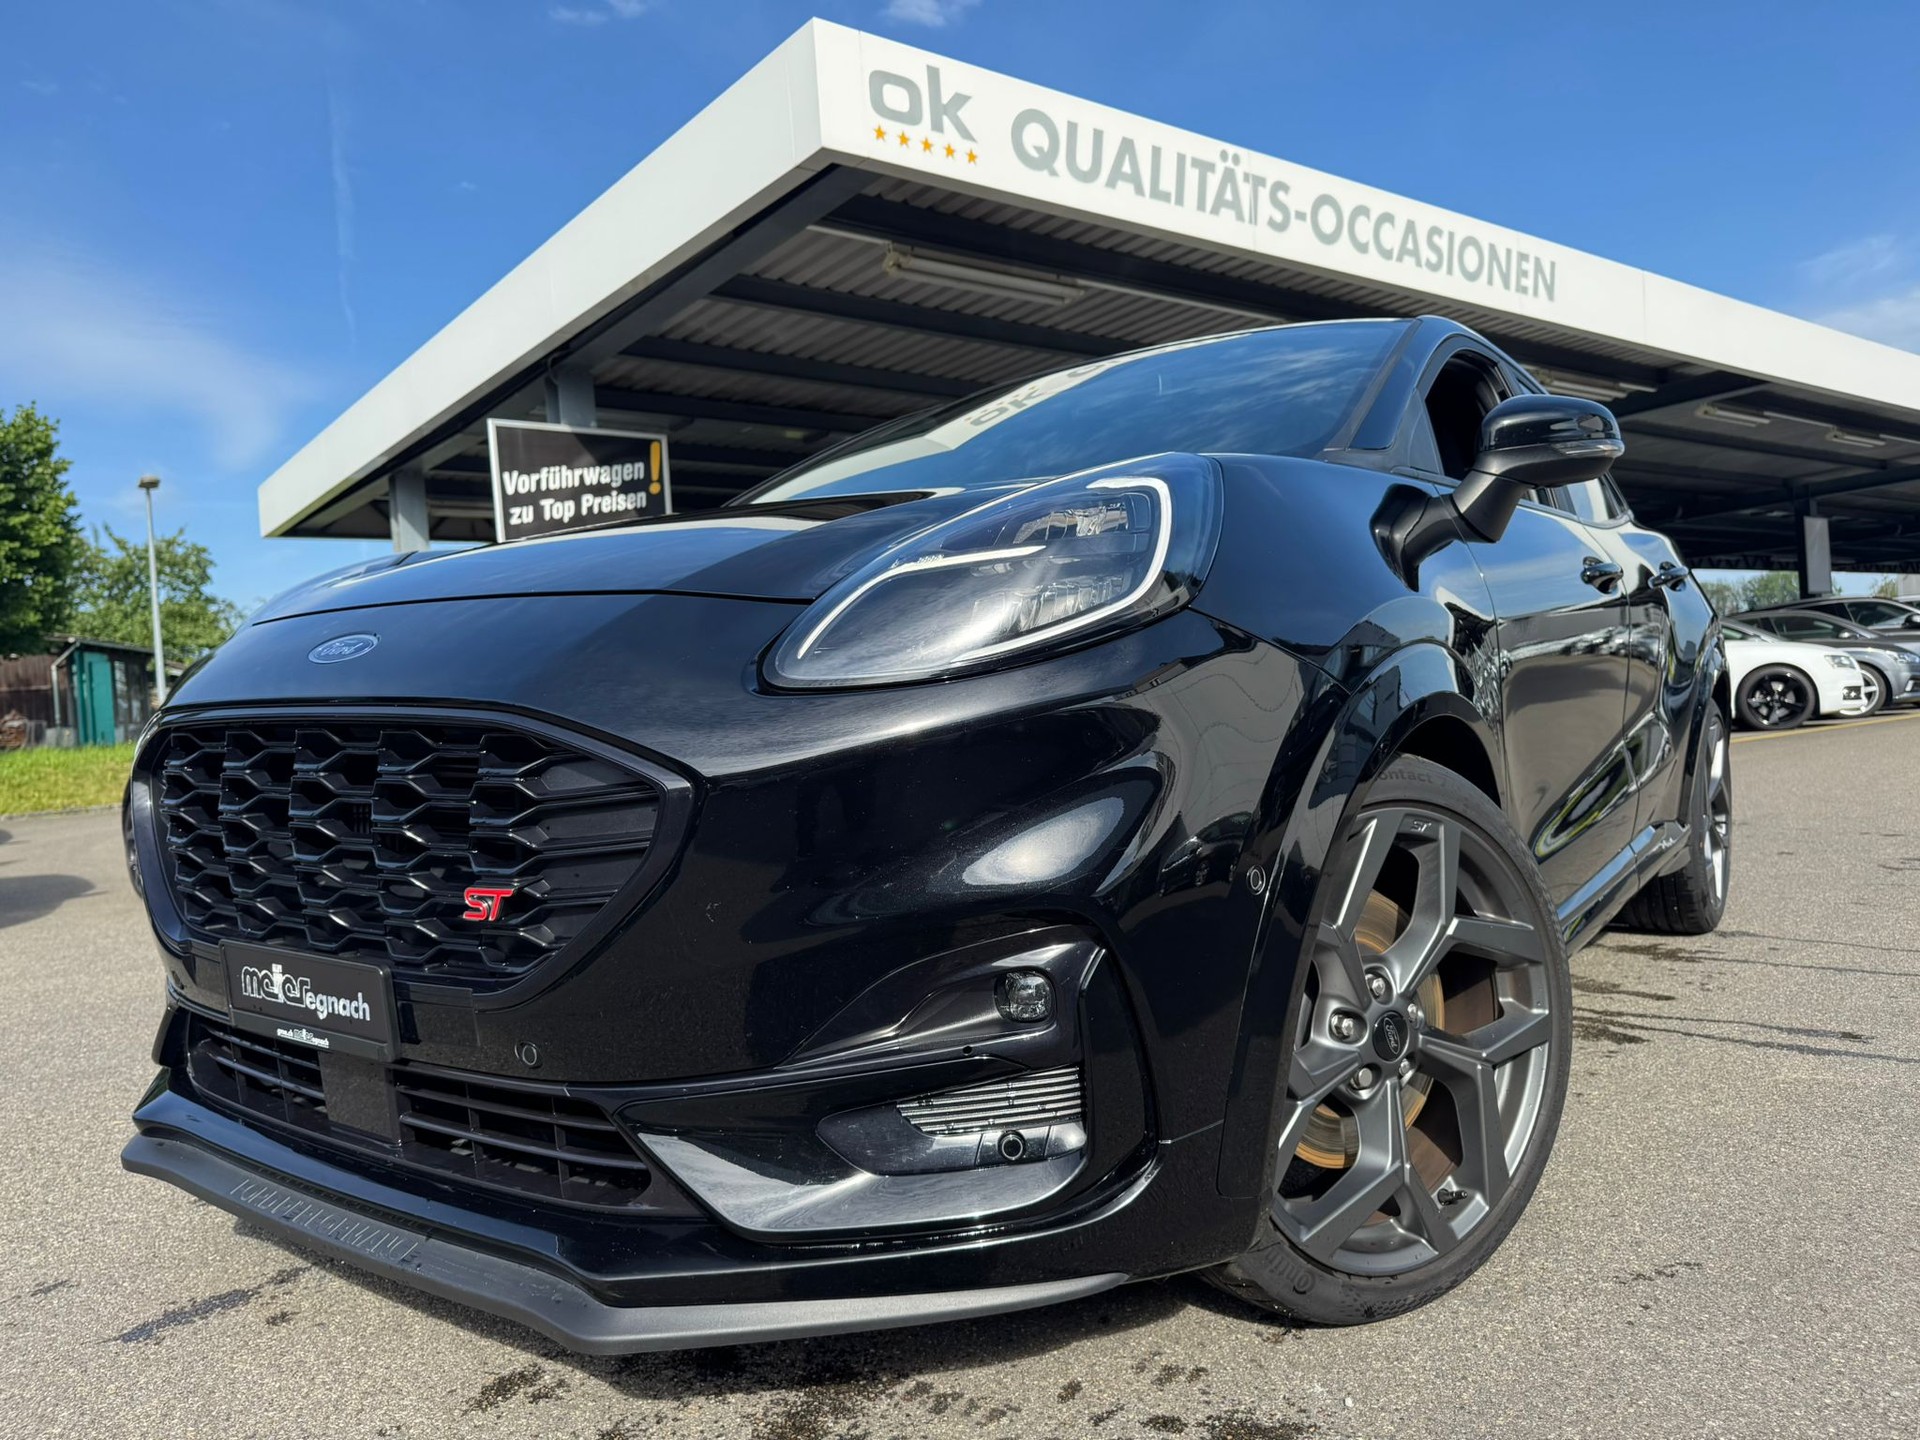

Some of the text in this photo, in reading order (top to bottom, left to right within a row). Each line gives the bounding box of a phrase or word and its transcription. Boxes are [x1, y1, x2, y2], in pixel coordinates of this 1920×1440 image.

[868, 64, 1556, 302] ok QUALITÄTS-OCCASIONEN
[502, 461, 645, 497] Vorführwagen
[509, 489, 647, 526] zu Top Preisen
[462, 887, 515, 921] ST
[1385, 1024, 1399, 1049] Ford
